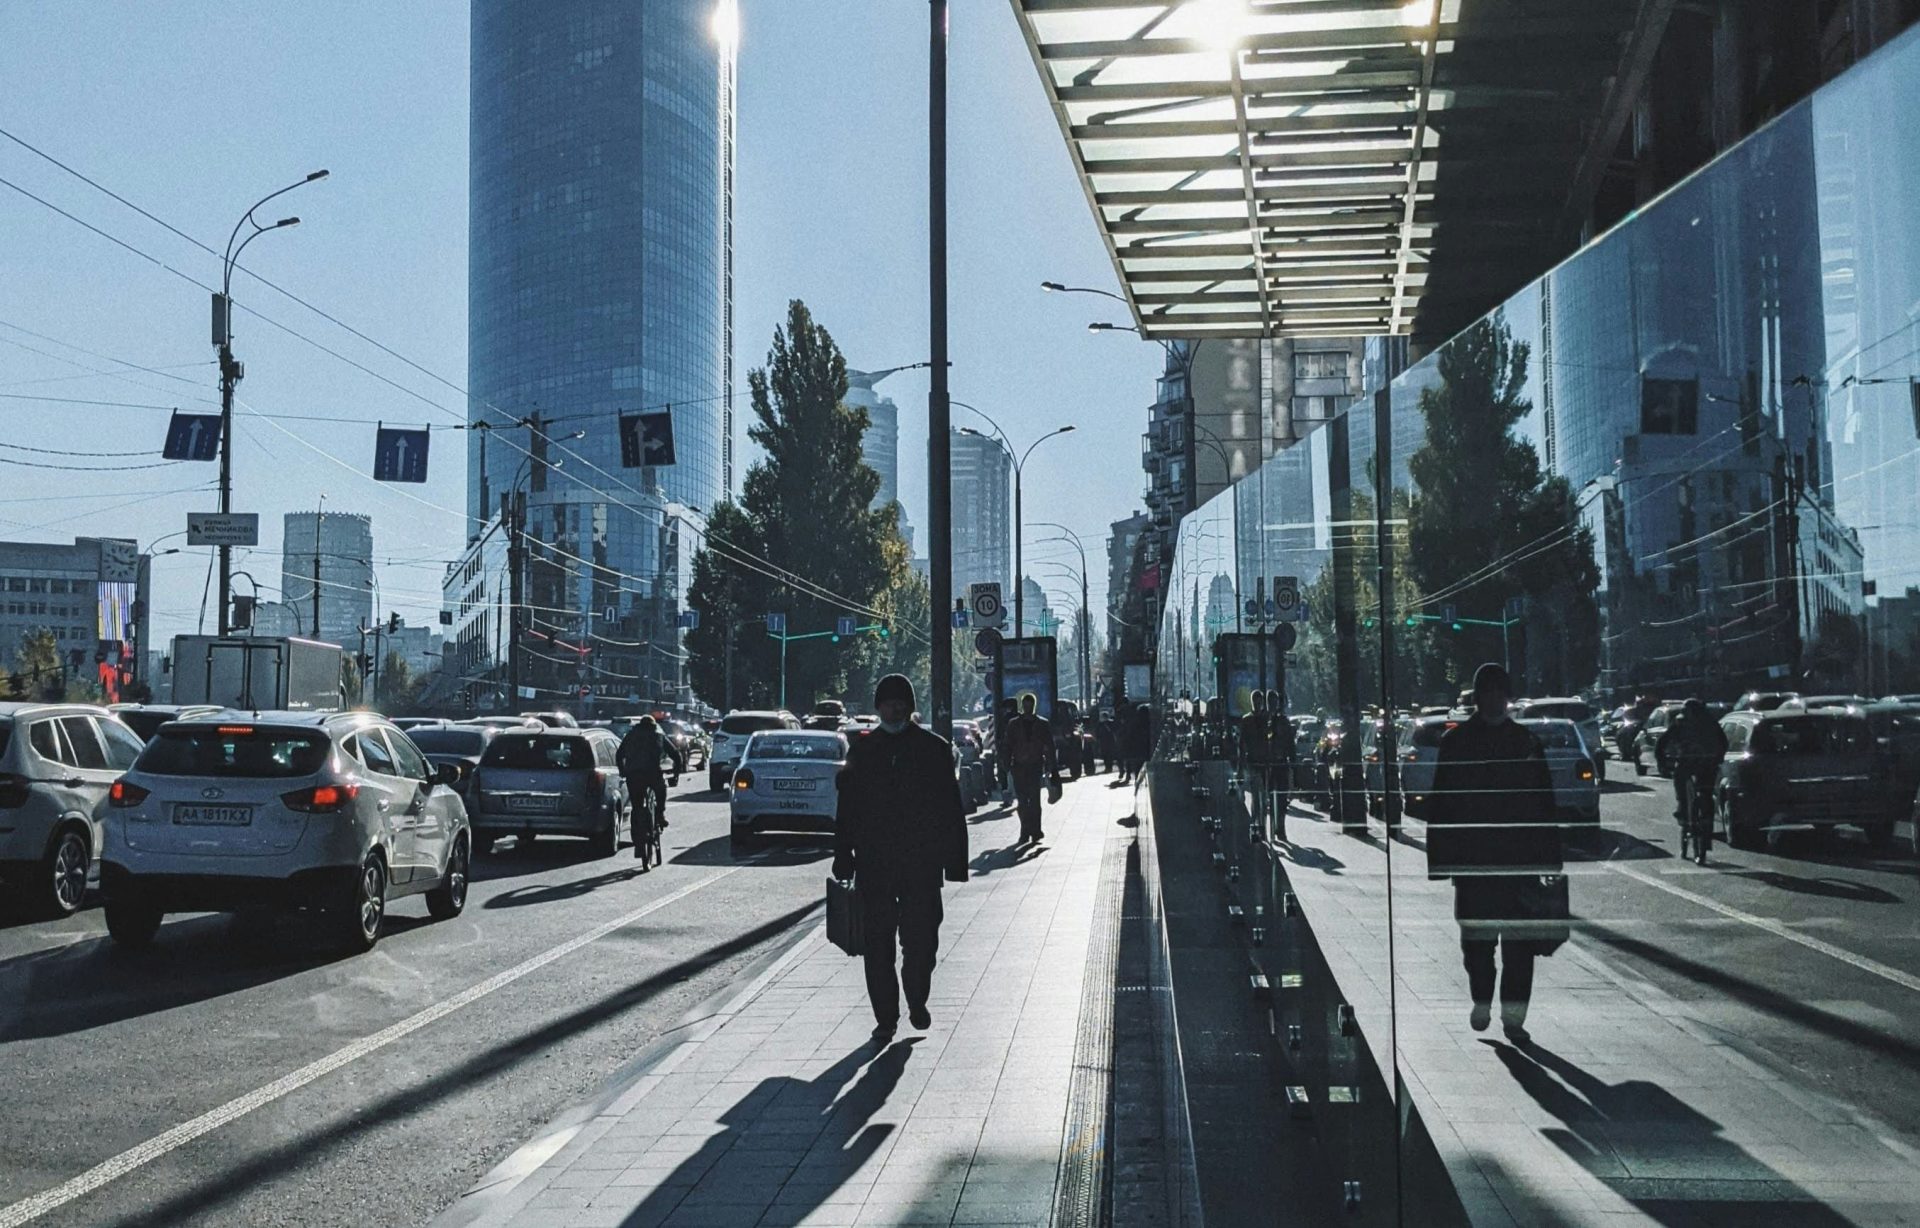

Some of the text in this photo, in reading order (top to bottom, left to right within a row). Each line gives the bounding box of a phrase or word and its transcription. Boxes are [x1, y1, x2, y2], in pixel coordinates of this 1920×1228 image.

[973, 585, 998, 594] ЗОНА
[980, 600, 993, 611] 10
[779, 799, 809, 810] uklon
